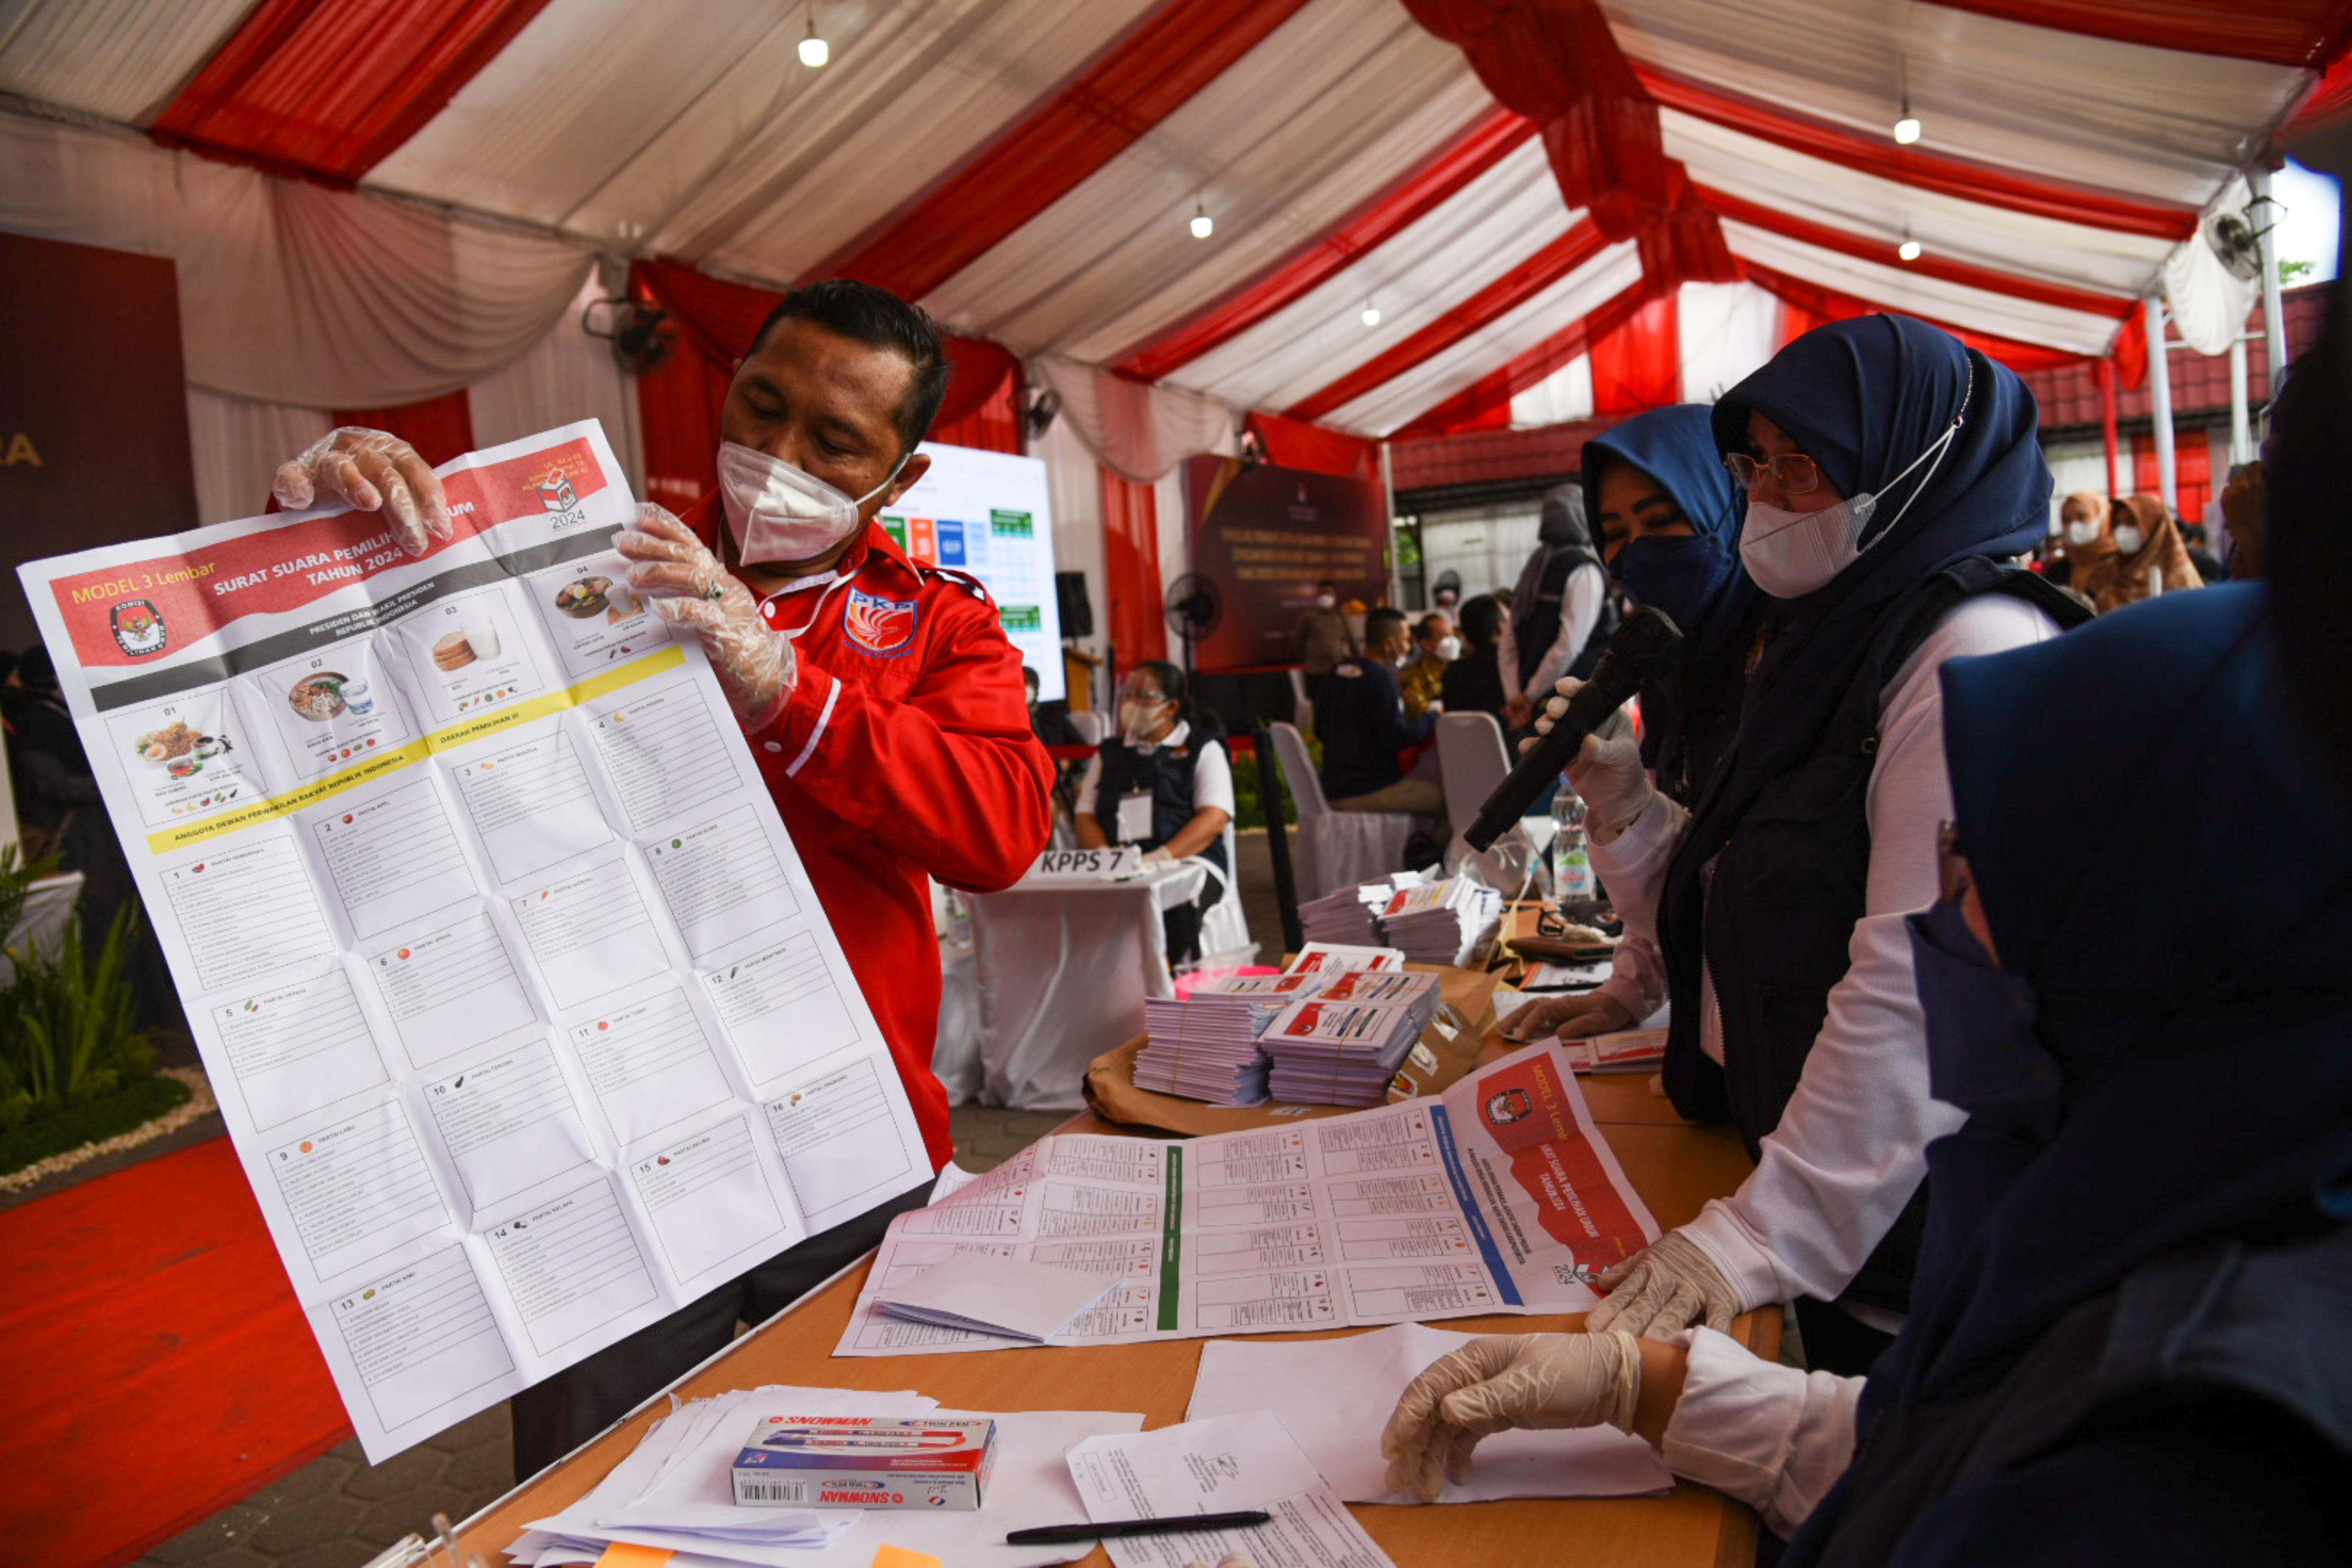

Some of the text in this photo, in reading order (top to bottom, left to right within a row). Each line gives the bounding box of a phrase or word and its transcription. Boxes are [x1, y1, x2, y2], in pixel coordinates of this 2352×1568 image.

[550, 510, 585, 529] 2024
[213, 502, 475, 596] SURAT SUARA PEMILIH UM
[306, 547, 403, 586] TAHUN 2024
[576, 565, 589, 575] 04
[72, 563, 216, 604] MODEL 3 Lembar
[115, 600, 145, 611] KOMISI
[309, 616, 350, 636] PRESIDEN
[351, 610, 371, 622] DAN
[397, 581, 435, 602] PRESIDEN
[853, 592, 911, 610] PKP
[335, 599, 419, 637] REPUBLIK INDONESIA
[445, 606, 457, 616] 03
[310, 659, 323, 669] 02
[163, 706, 176, 716] 01
[174, 754, 405, 842] ANGGOTA DEWAN PERWAKILAN RAKYAT REPUBLIK INDONESIA
[325, 824, 332, 833] 2
[376, 801, 391, 810] APEL
[1040, 851, 1125, 872] KPPS 7
[712, 975, 723, 984] 12
[225, 1008, 233, 1017] 5
[579, 1028, 589, 1037] 11
[433, 1085, 446, 1095] 10
[1532, 1064, 1553, 1102] MODEL
[280, 1152, 288, 1161] 9
[339, 1124, 356, 1134] LABU
[639, 1163, 652, 1174] 15
[1549, 1159, 1568, 1183] SUARA
[495, 1228, 507, 1239] 14
[1555, 1263, 1575, 1285] 2024
[340, 1299, 355, 1311] 13
[785, 1416, 875, 1426] SNOWMAN
[820, 1490, 890, 1504] SNOWMAN
